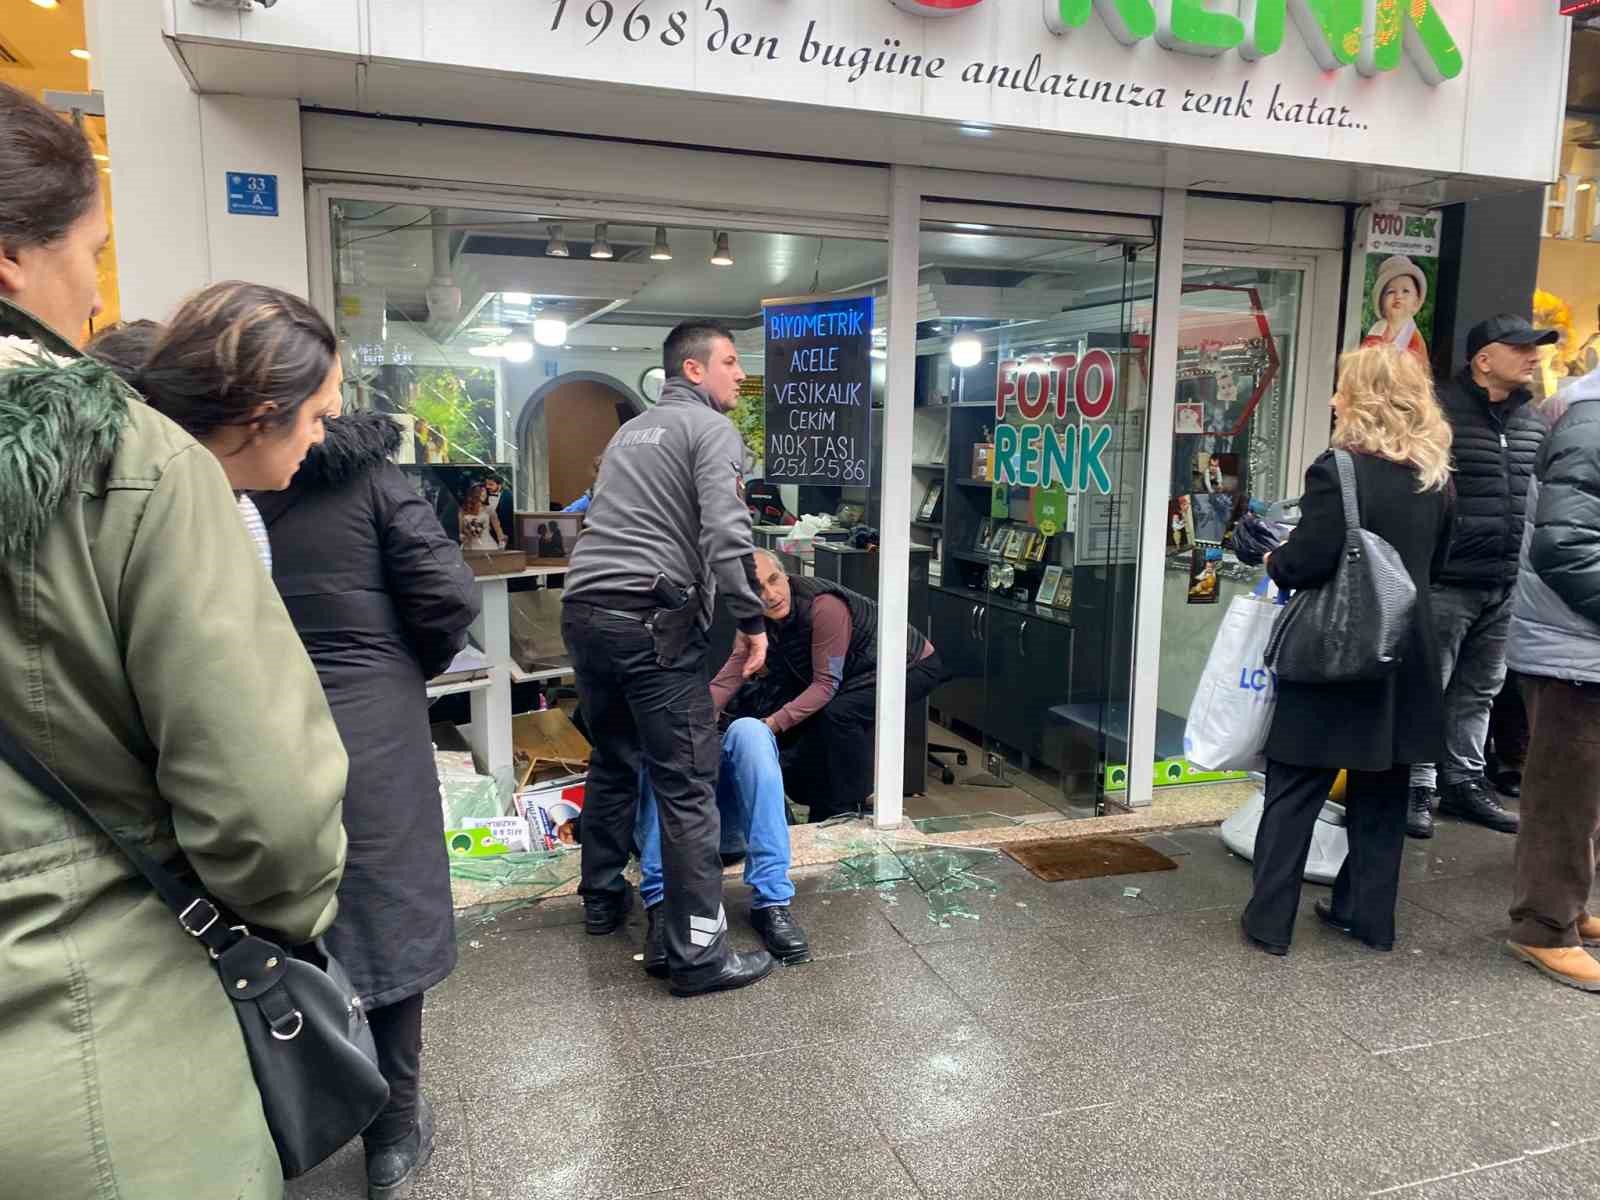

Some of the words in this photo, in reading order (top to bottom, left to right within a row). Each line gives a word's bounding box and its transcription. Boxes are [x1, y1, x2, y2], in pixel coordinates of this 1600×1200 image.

[799, 20, 946, 83] bugüne
[961, 54, 1165, 109] anılarınıza
[1182, 80, 1253, 119] renk
[1266, 83, 1369, 130] katar...
[248, 176, 266, 191] 33
[252, 193, 264, 206] A
[1372, 213, 1403, 236] FOTO
[1404, 215, 1438, 239] RENK
[770, 308, 865, 340] BİYOMETRİK
[789, 347, 840, 373] ACELE
[996, 347, 1116, 421] FOTO
[770, 434, 856, 460] NOKTASI
[993, 423, 1113, 495] RENK
[1239, 667, 1266, 691] LC
